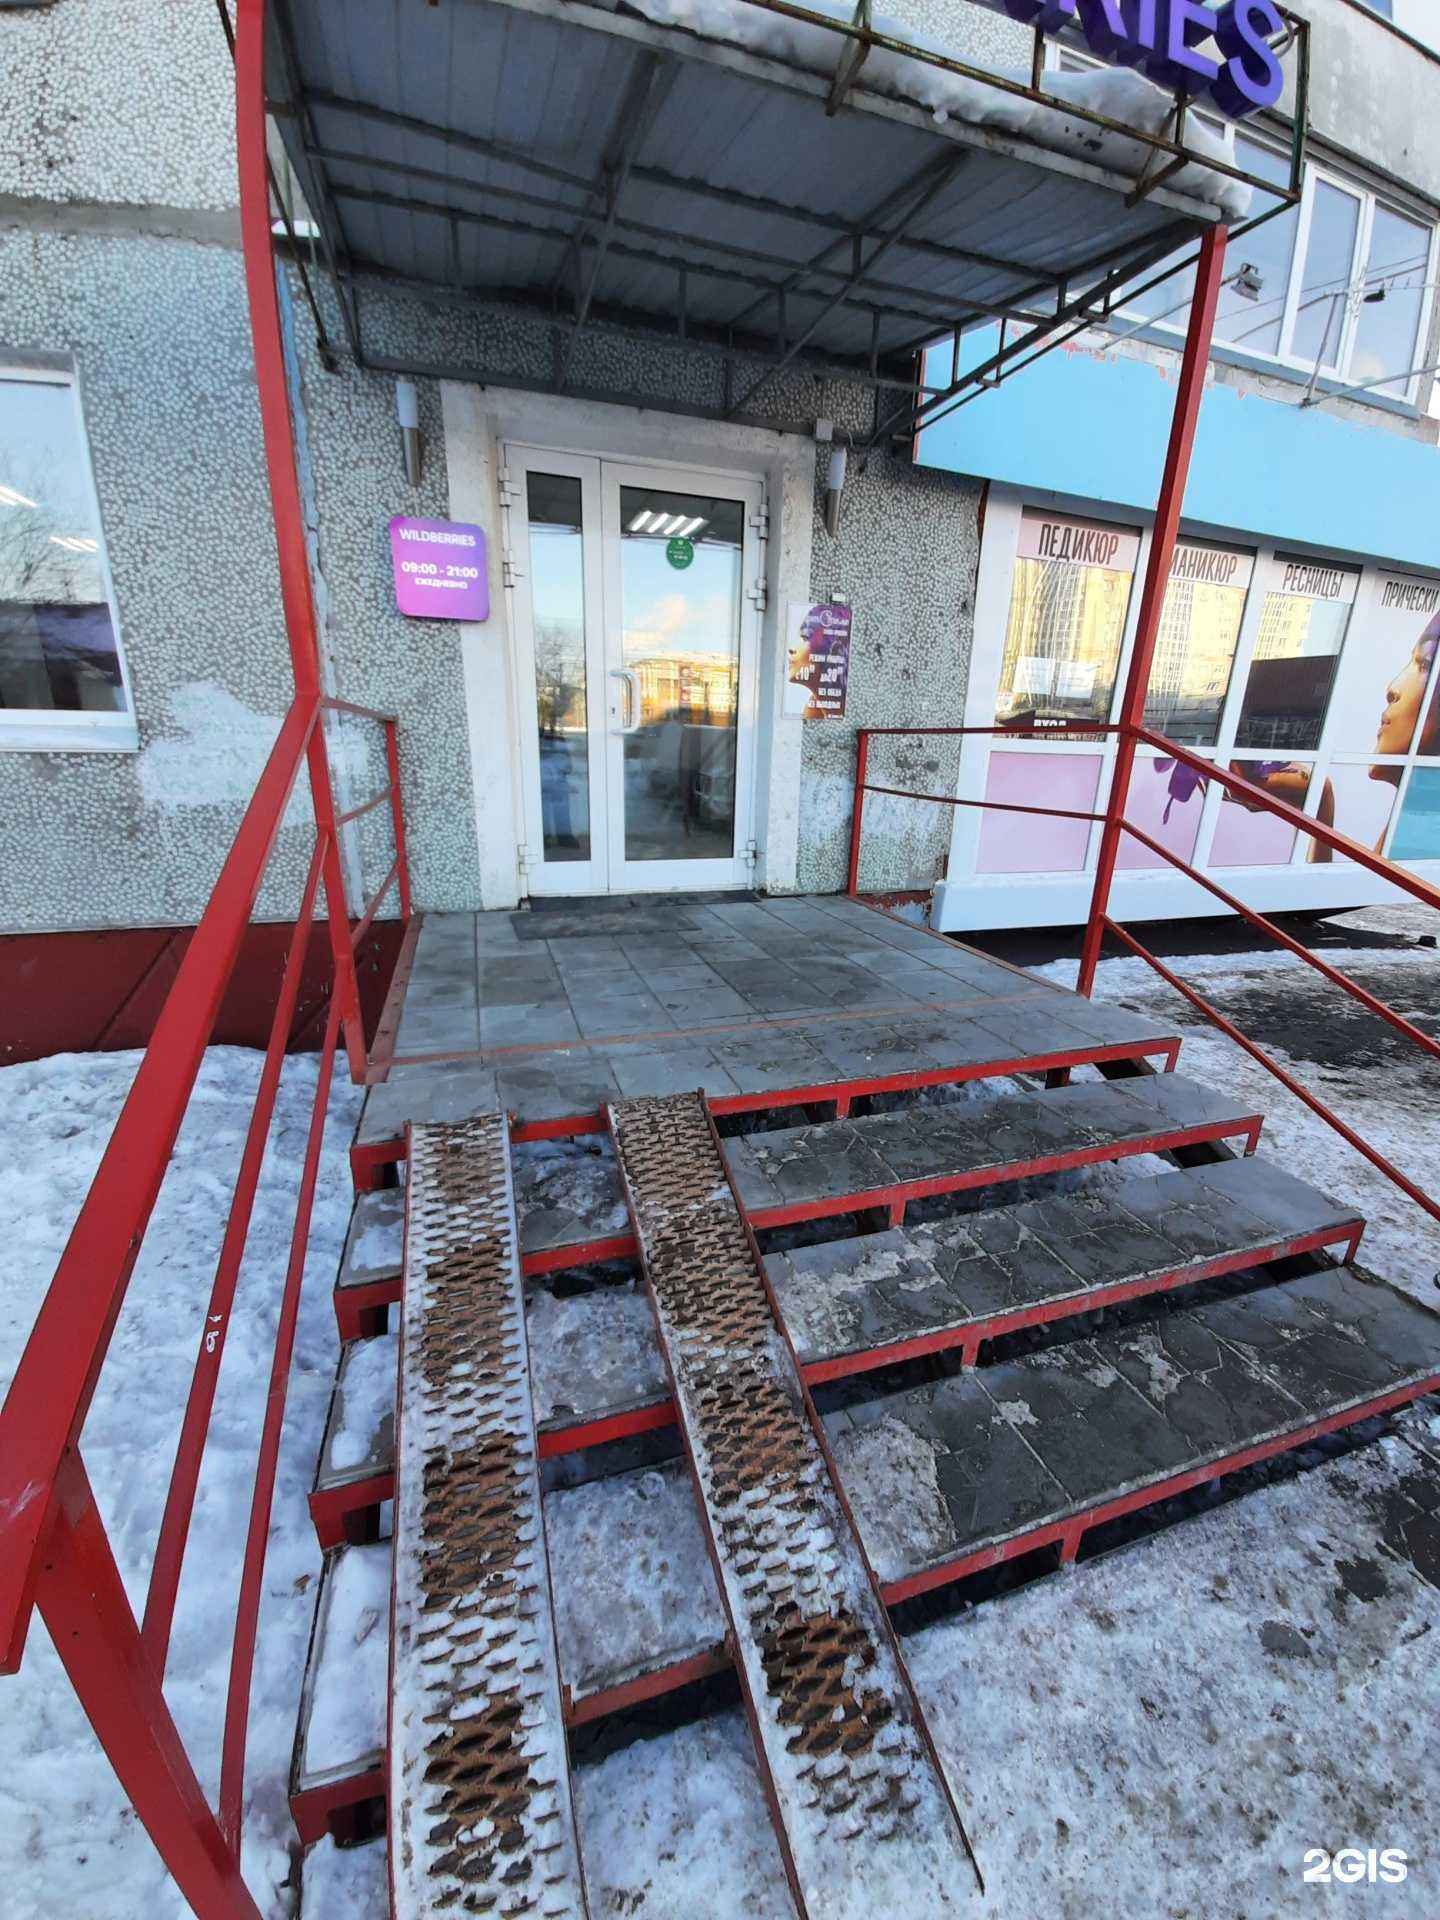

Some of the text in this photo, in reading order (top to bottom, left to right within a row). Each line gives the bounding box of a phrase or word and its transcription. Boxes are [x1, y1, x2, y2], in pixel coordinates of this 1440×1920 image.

[399, 528, 476, 547] WILDBERRIES
[1038, 523, 1119, 565] ПЕДИКЮР
[401, 561, 437, 575] 09:00
[446, 564, 478, 578] 21:00
[1282, 563, 1344, 598] РЕСНИЦЫ
[1381, 580, 1439, 613] ПРИЧЕСКИ
